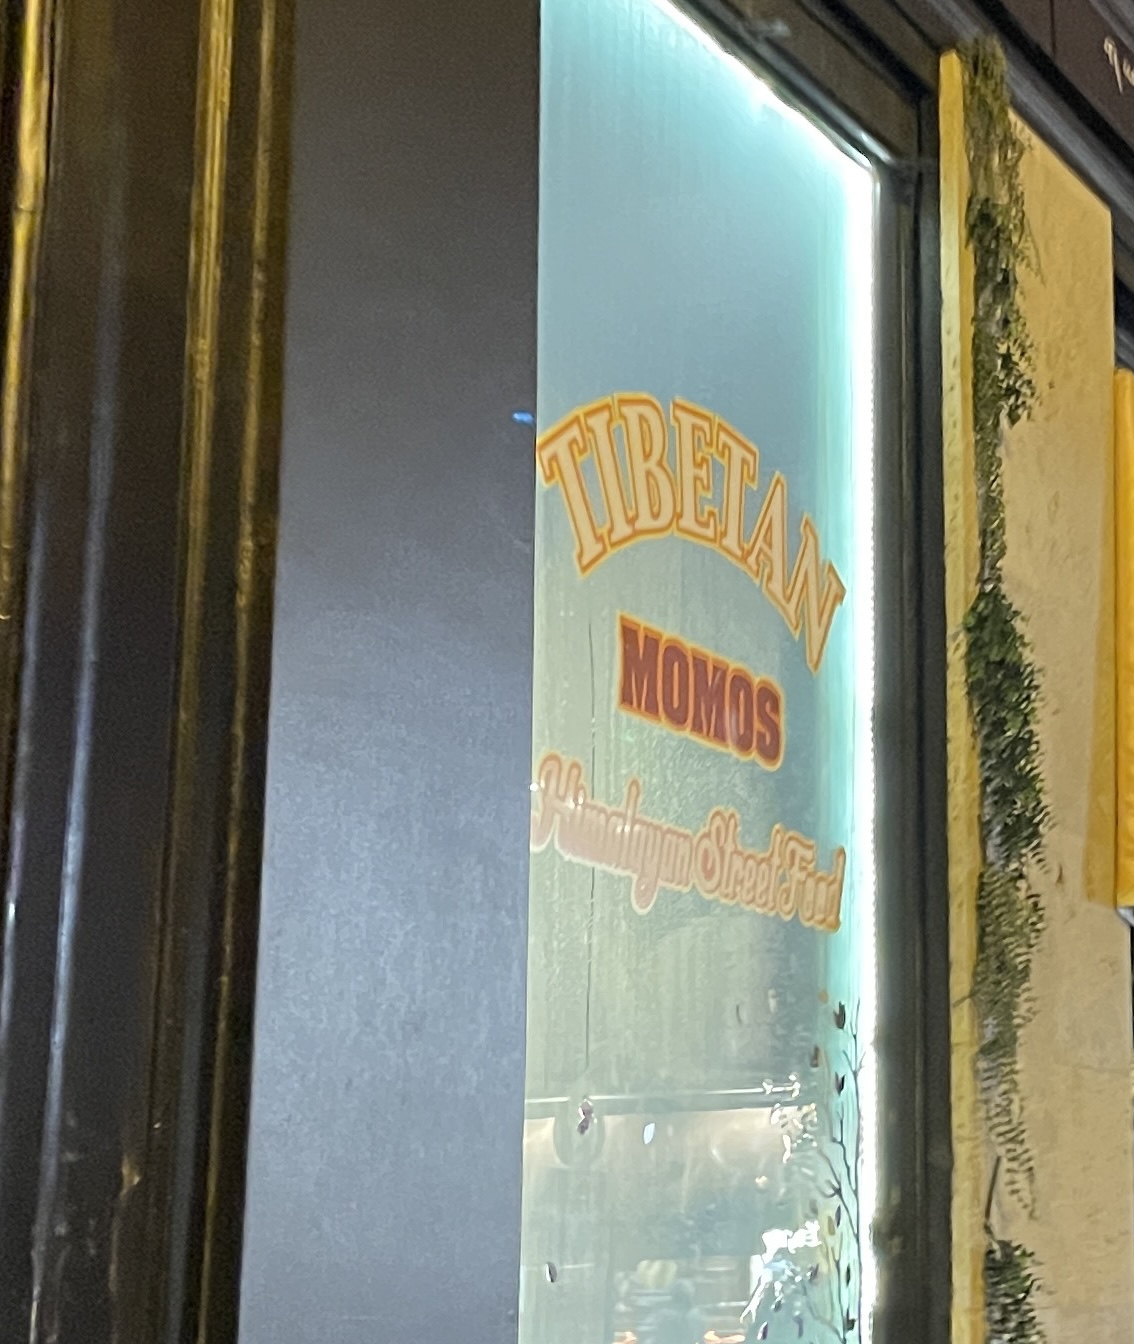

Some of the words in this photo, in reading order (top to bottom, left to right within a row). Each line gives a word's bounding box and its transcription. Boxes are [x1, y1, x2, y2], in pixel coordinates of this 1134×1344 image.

[536, 390, 847, 675] TIBETAN
[617, 610, 783, 773] MOMOS
[531, 751, 693, 914] Himalayan
[694, 805, 783, 919] Street
[775, 830, 846, 933] Food
